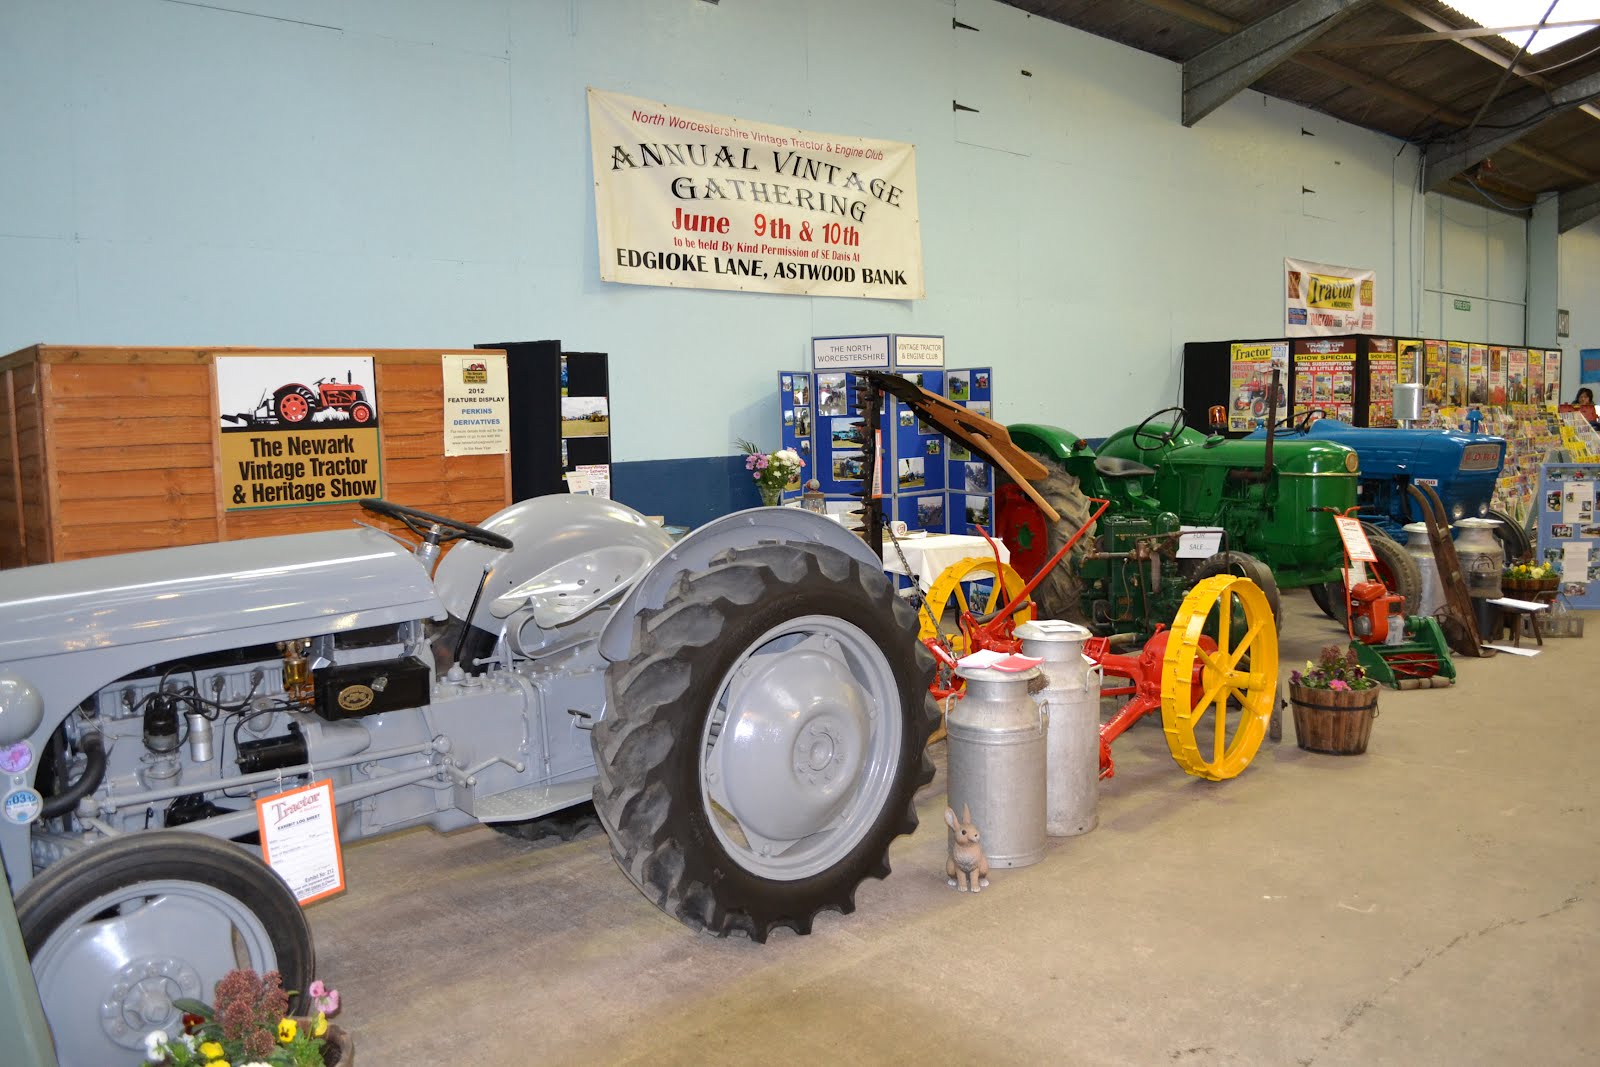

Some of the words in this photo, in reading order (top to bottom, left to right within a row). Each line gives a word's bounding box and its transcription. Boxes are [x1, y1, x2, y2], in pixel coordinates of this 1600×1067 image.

[632, 110, 665, 126] North
[669, 116, 749, 140] Worcestershire
[751, 131, 788, 147] Vintage
[790, 137, 824, 151] Tractor
[826, 143, 833, 153] &
[835, 144, 864, 158] Engine
[865, 149, 884, 161] Club
[611, 143, 760, 171] ANNUAL
[772, 150, 904, 208] VINTAGE
[671, 176, 868, 223] GATHERING
[671, 207, 730, 234] June
[754, 213, 791, 240] 9th
[799, 220, 813, 242] &
[822, 222, 860, 247] 10th
[673, 236, 683, 247] to
[685, 237, 696, 249] be
[698, 239, 718, 251] held
[722, 241, 733, 253] By
[737, 242, 758, 254] Kind
[761, 244, 809, 258] Permission
[811, 249, 819, 259] of
[821, 250, 830, 260] SE
[832, 251, 850, 261] Davis
[616, 248, 709, 273] EDGIOKE
[714, 257, 768, 280] LANE,
[773, 261, 856, 283] ASTWOOD
[862, 268, 908, 285] BANK
[1310, 276, 1355, 304] Tractor
[817, 353, 885, 362] WORCESTERSHIRE
[830, 345, 844, 353] THE
[898, 343, 919, 351] VINTAGE
[1235, 347, 1271, 360] Tractor
[453, 418, 501, 426] DERIVATIVES
[250, 437, 283, 458] The
[287, 434, 355, 456] Newark
[239, 460, 305, 481] Vintage
[309, 458, 368, 476] Tractor
[232, 484, 246, 505] &
[252, 481, 326, 503] Heritage
[330, 478, 377, 498] Show
[272, 792, 320, 823] Tractor
